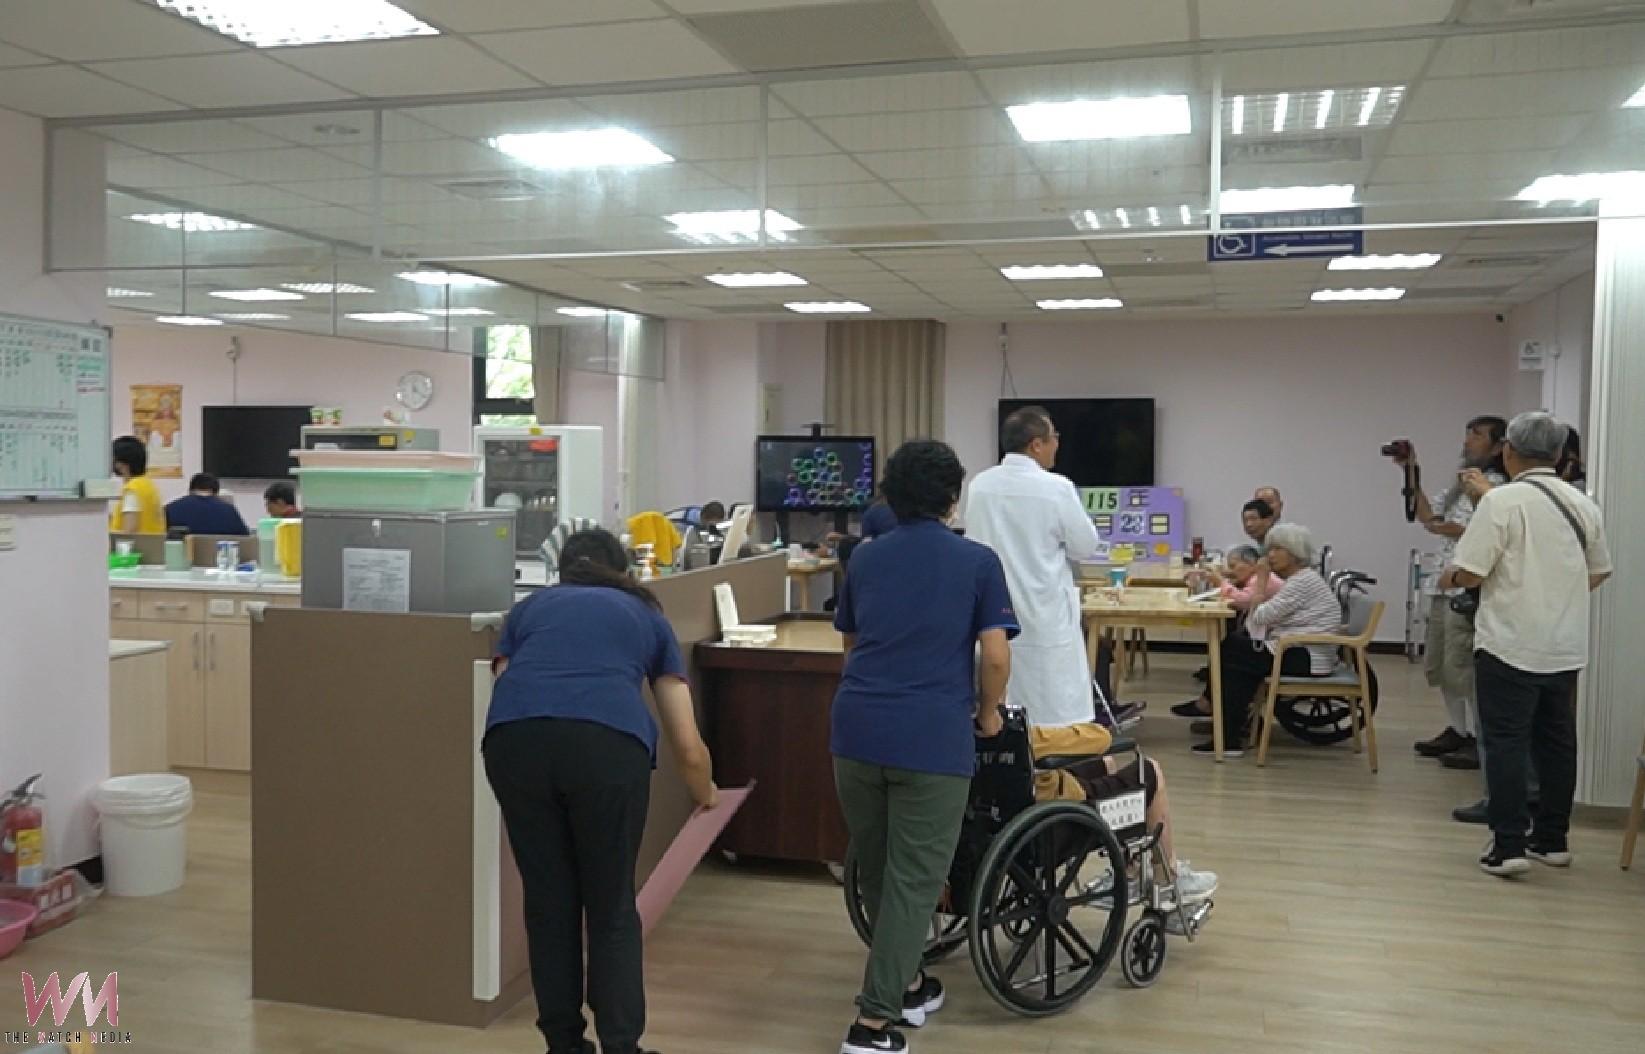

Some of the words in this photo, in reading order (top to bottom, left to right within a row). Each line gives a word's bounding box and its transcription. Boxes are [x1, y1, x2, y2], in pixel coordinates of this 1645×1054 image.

[1086, 492, 1118, 510] 115
[1128, 488, 1150, 508] 年
[1149, 514, 1169, 535] 日
